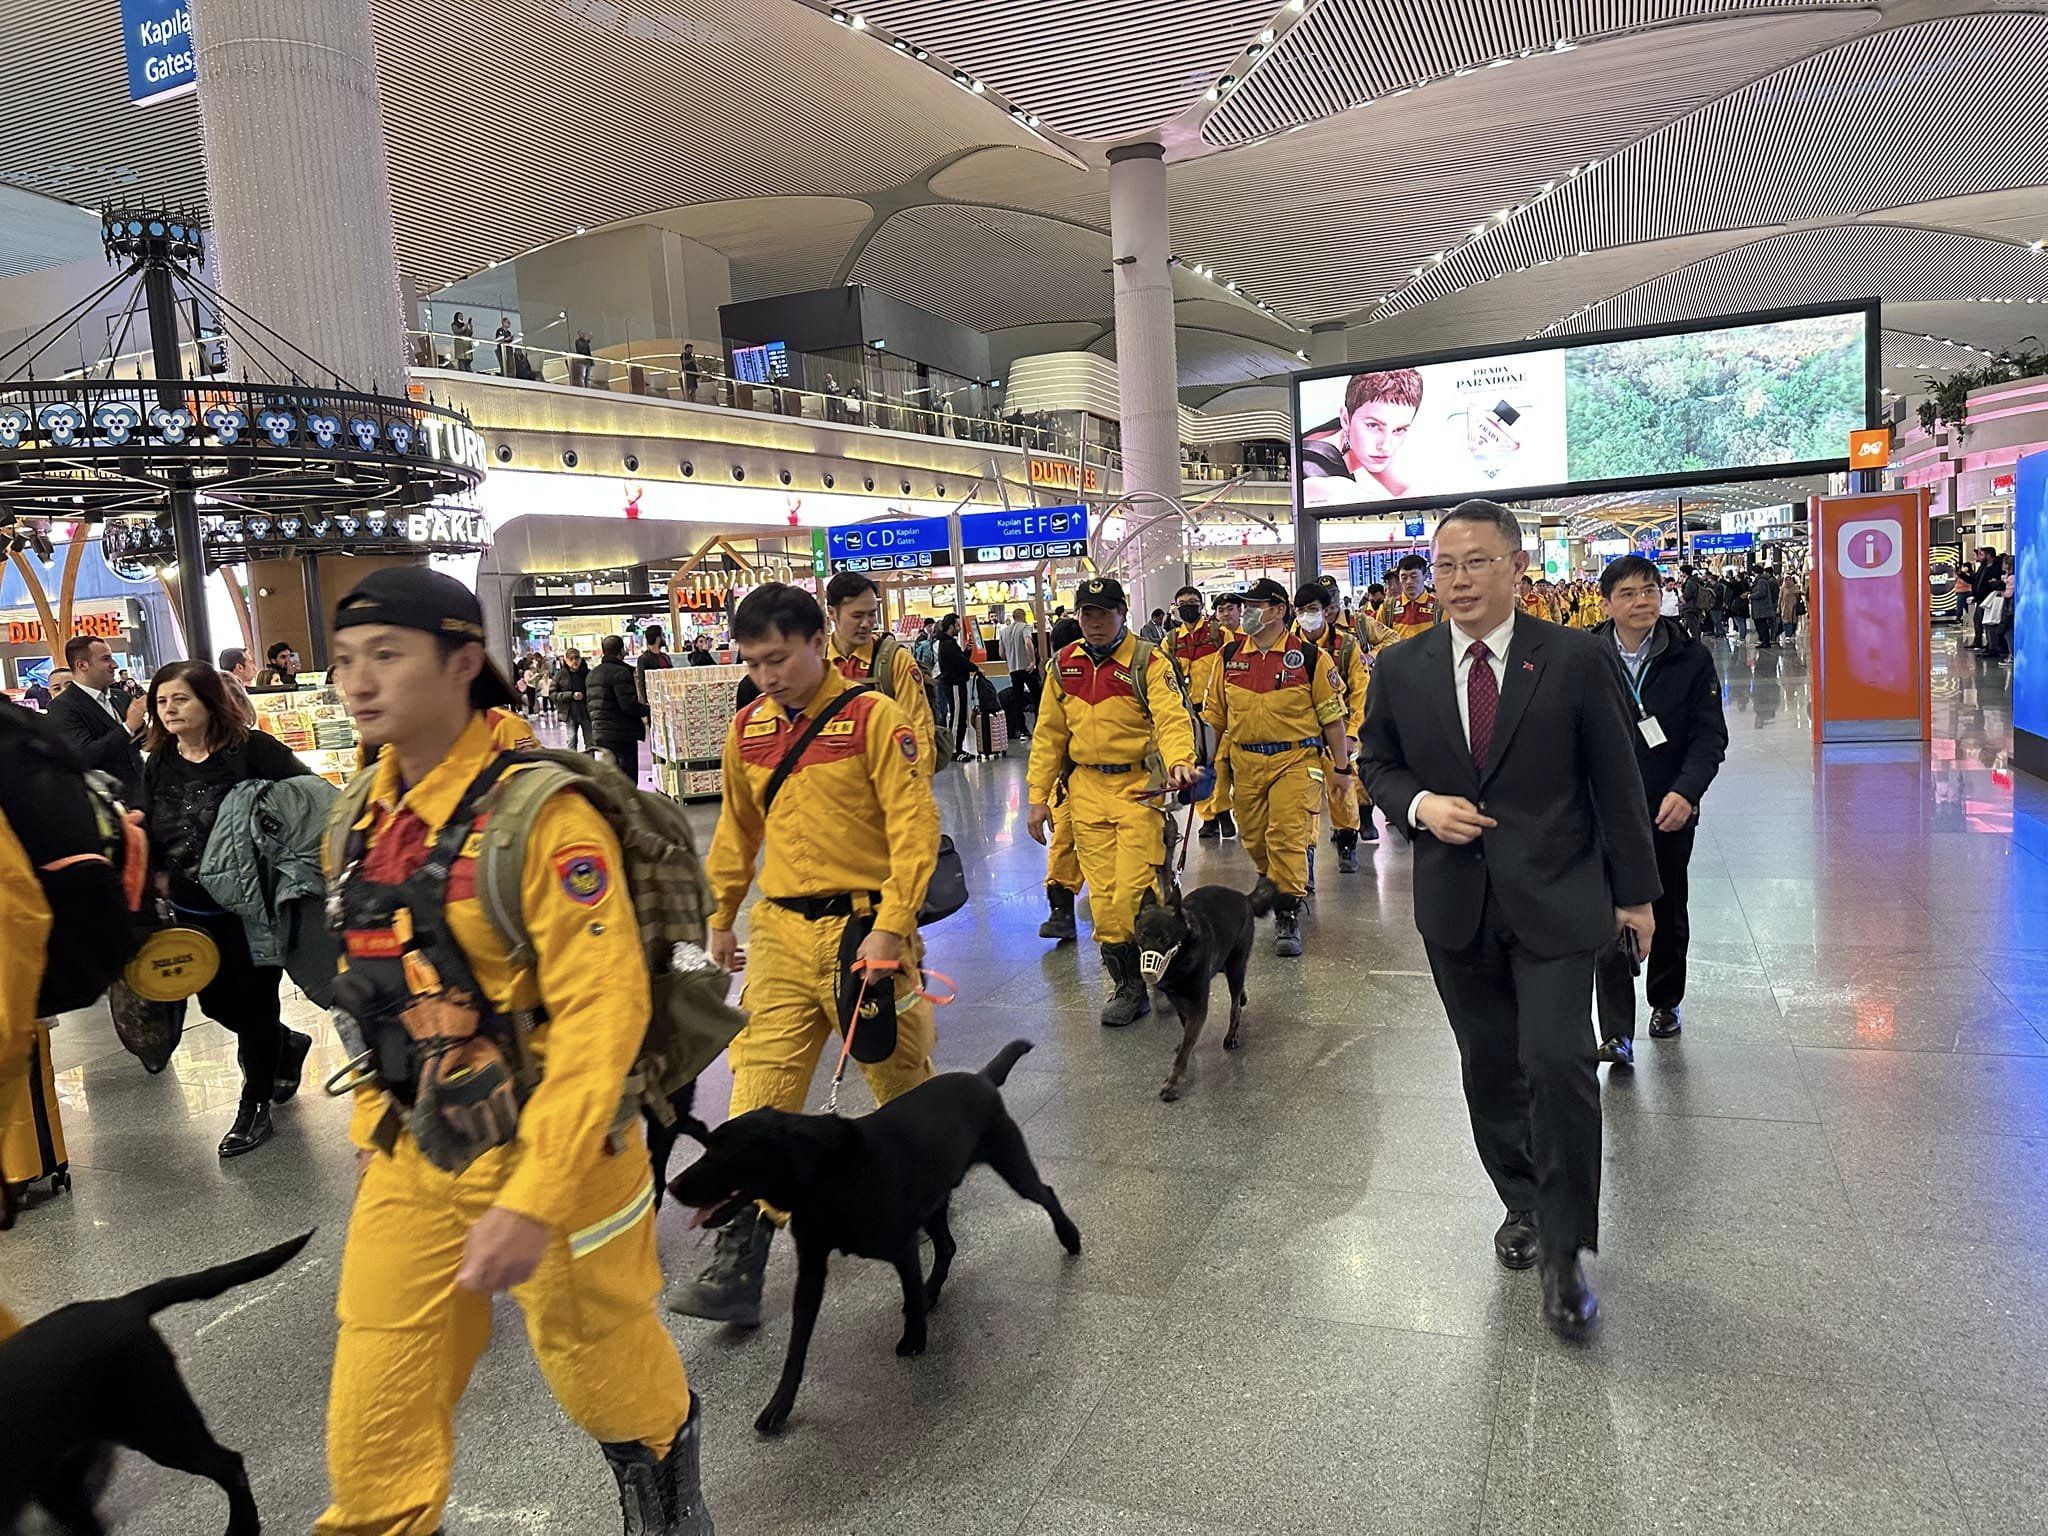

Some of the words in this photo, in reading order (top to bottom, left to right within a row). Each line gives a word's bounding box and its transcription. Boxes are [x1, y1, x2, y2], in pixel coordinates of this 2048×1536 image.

[145, 51, 193, 83] Gates
[1473, 366, 1508, 376] PRADA
[1456, 373, 1528, 389] PARADOXE
[1030, 460, 1071, 485] DUTY
[1074, 466, 1096, 489] FEE
[1024, 517, 1034, 534] E
[1038, 516, 1047, 533] F
[866, 531, 878, 547] C
[882, 530, 894, 546] D
[71, 612, 119, 637] FREE
